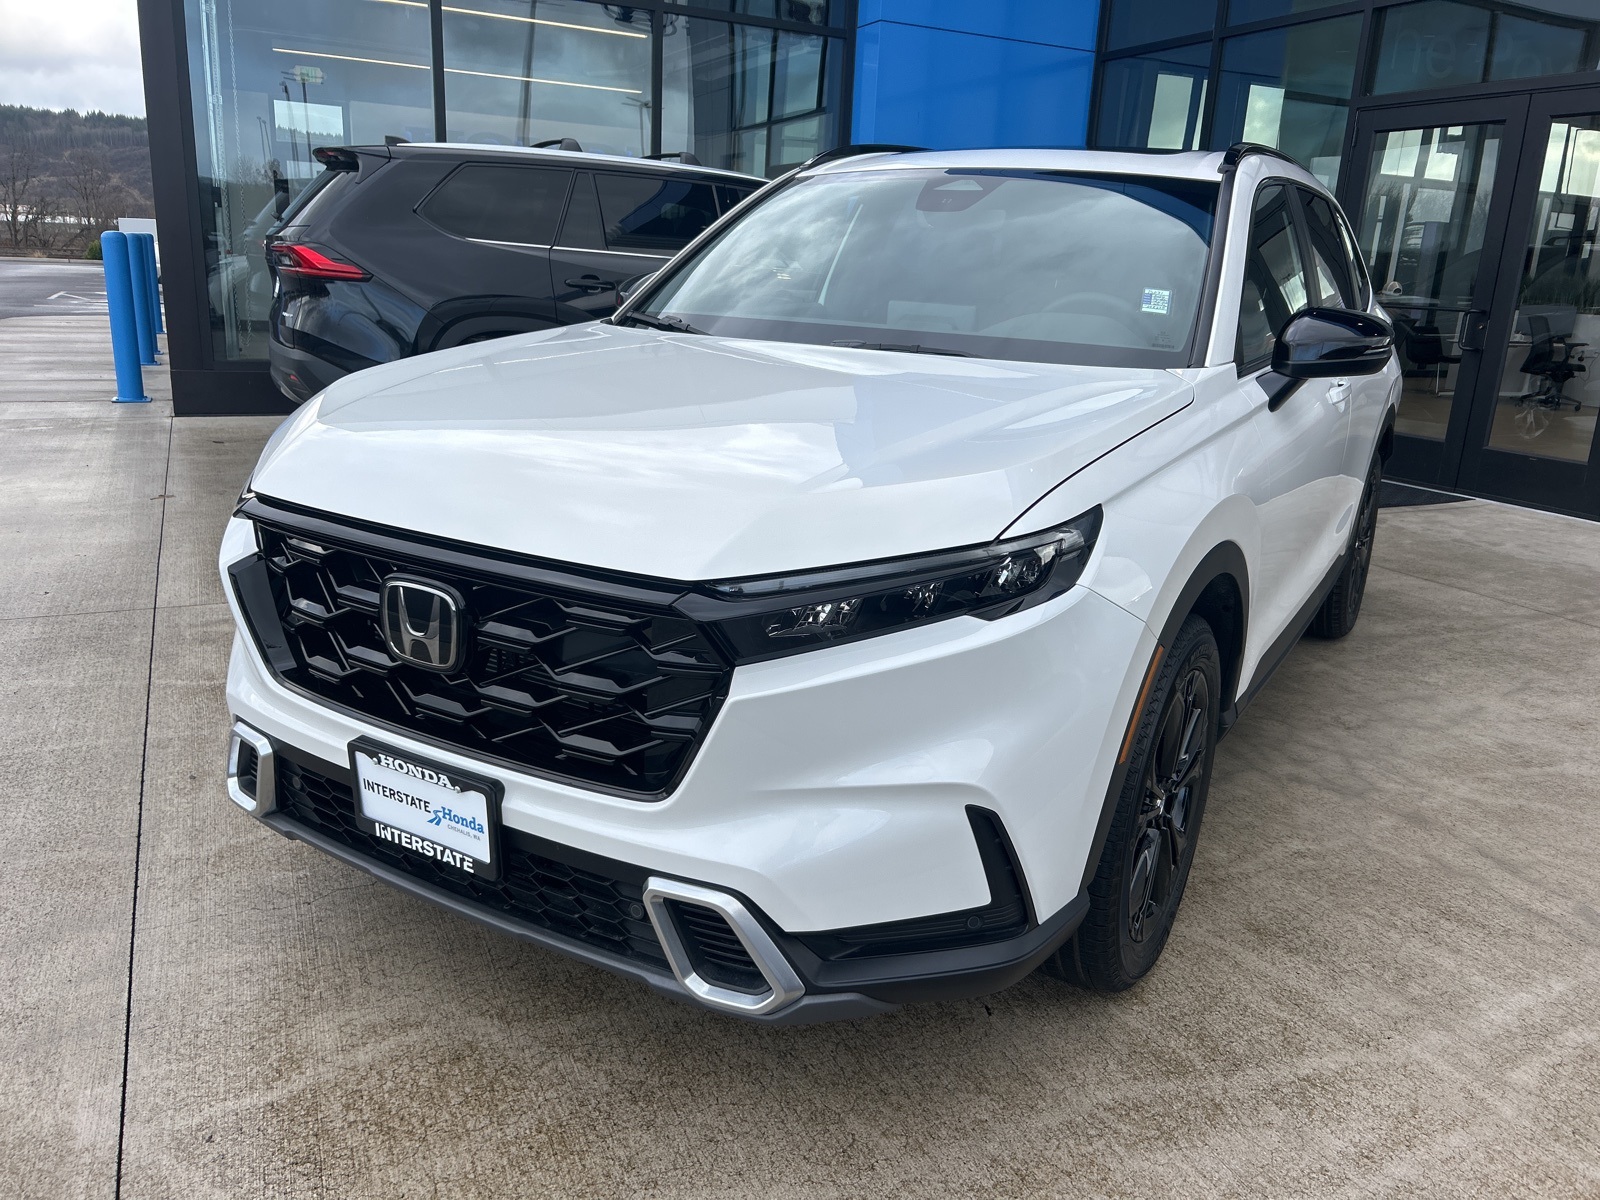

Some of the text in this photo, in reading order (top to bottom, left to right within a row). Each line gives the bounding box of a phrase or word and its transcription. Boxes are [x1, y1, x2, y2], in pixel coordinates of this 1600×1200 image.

[378, 754, 454, 790] HONDA
[363, 778, 485, 834] INTERSTATE Honda
[375, 822, 475, 873] INTERSTATE
